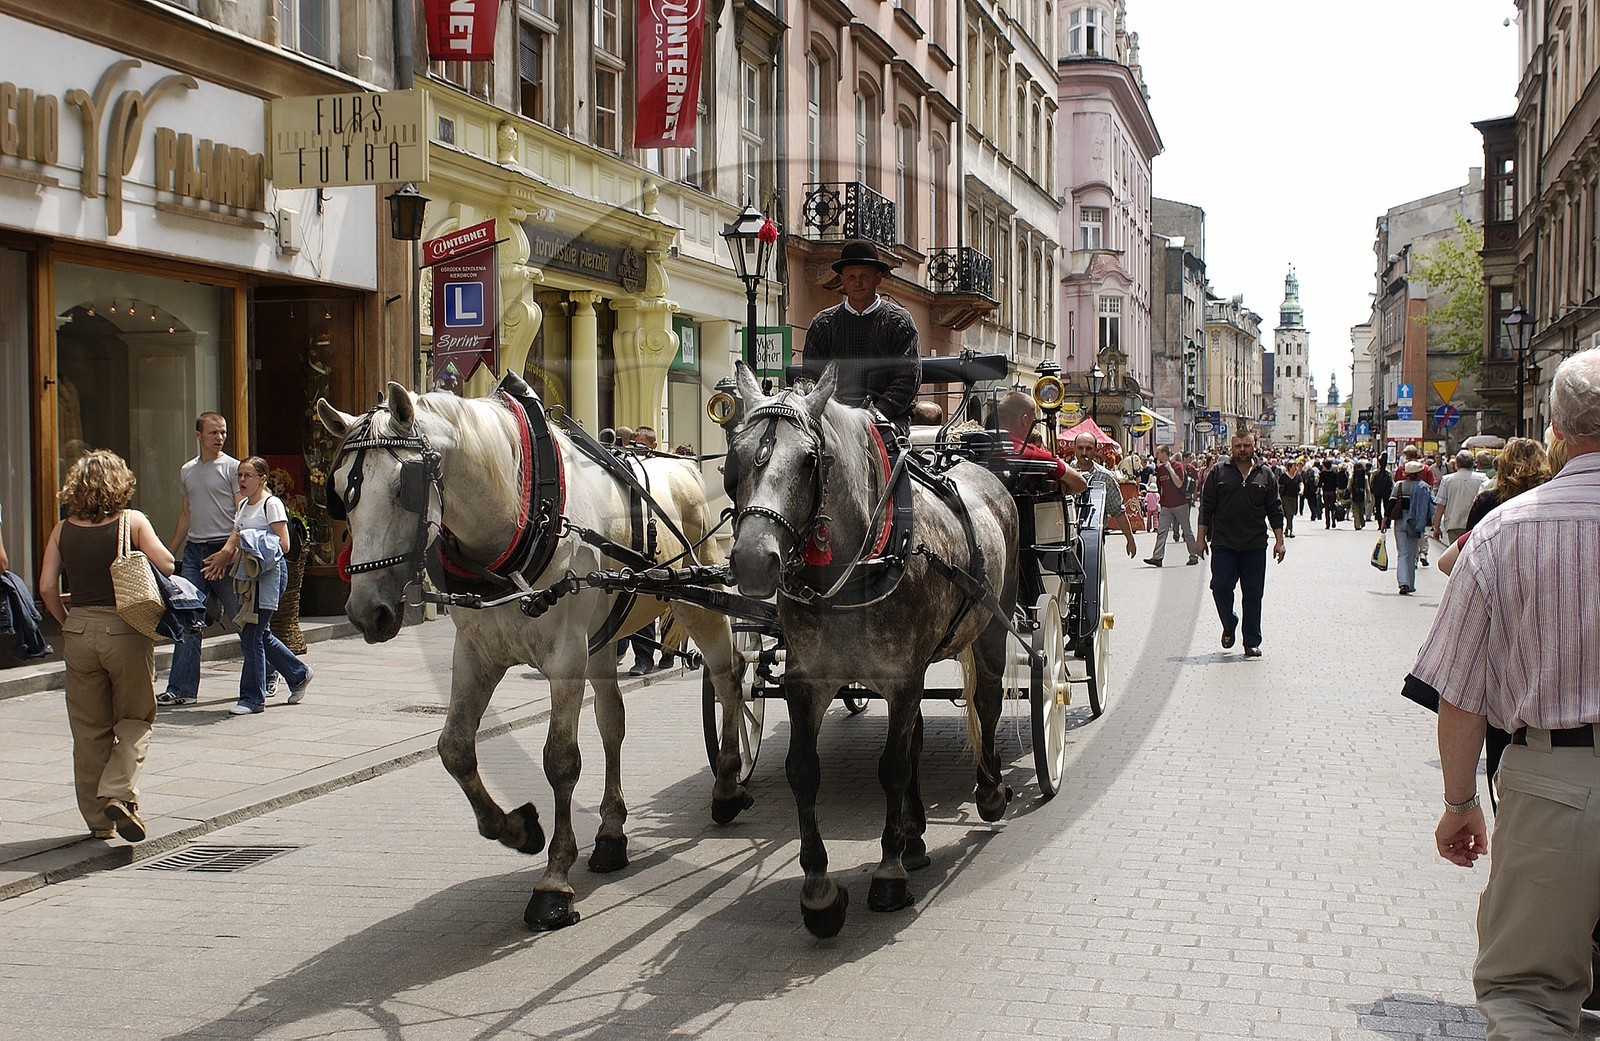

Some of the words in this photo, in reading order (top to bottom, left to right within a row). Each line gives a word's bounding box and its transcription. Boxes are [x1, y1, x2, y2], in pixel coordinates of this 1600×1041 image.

[655, 23, 663, 73] CAFE
[316, 94, 382, 135] FURS
[155, 127, 265, 212] PAJARO
[298, 141, 399, 184] FUTRA
[534, 236, 577, 264] toruńskie
[580, 248, 610, 272] pierniki
[455, 287, 477, 319] L
[437, 334, 491, 351] Sprint
[757, 352, 780, 362] ocher
[1188, 340, 1196, 408] APTEKA
